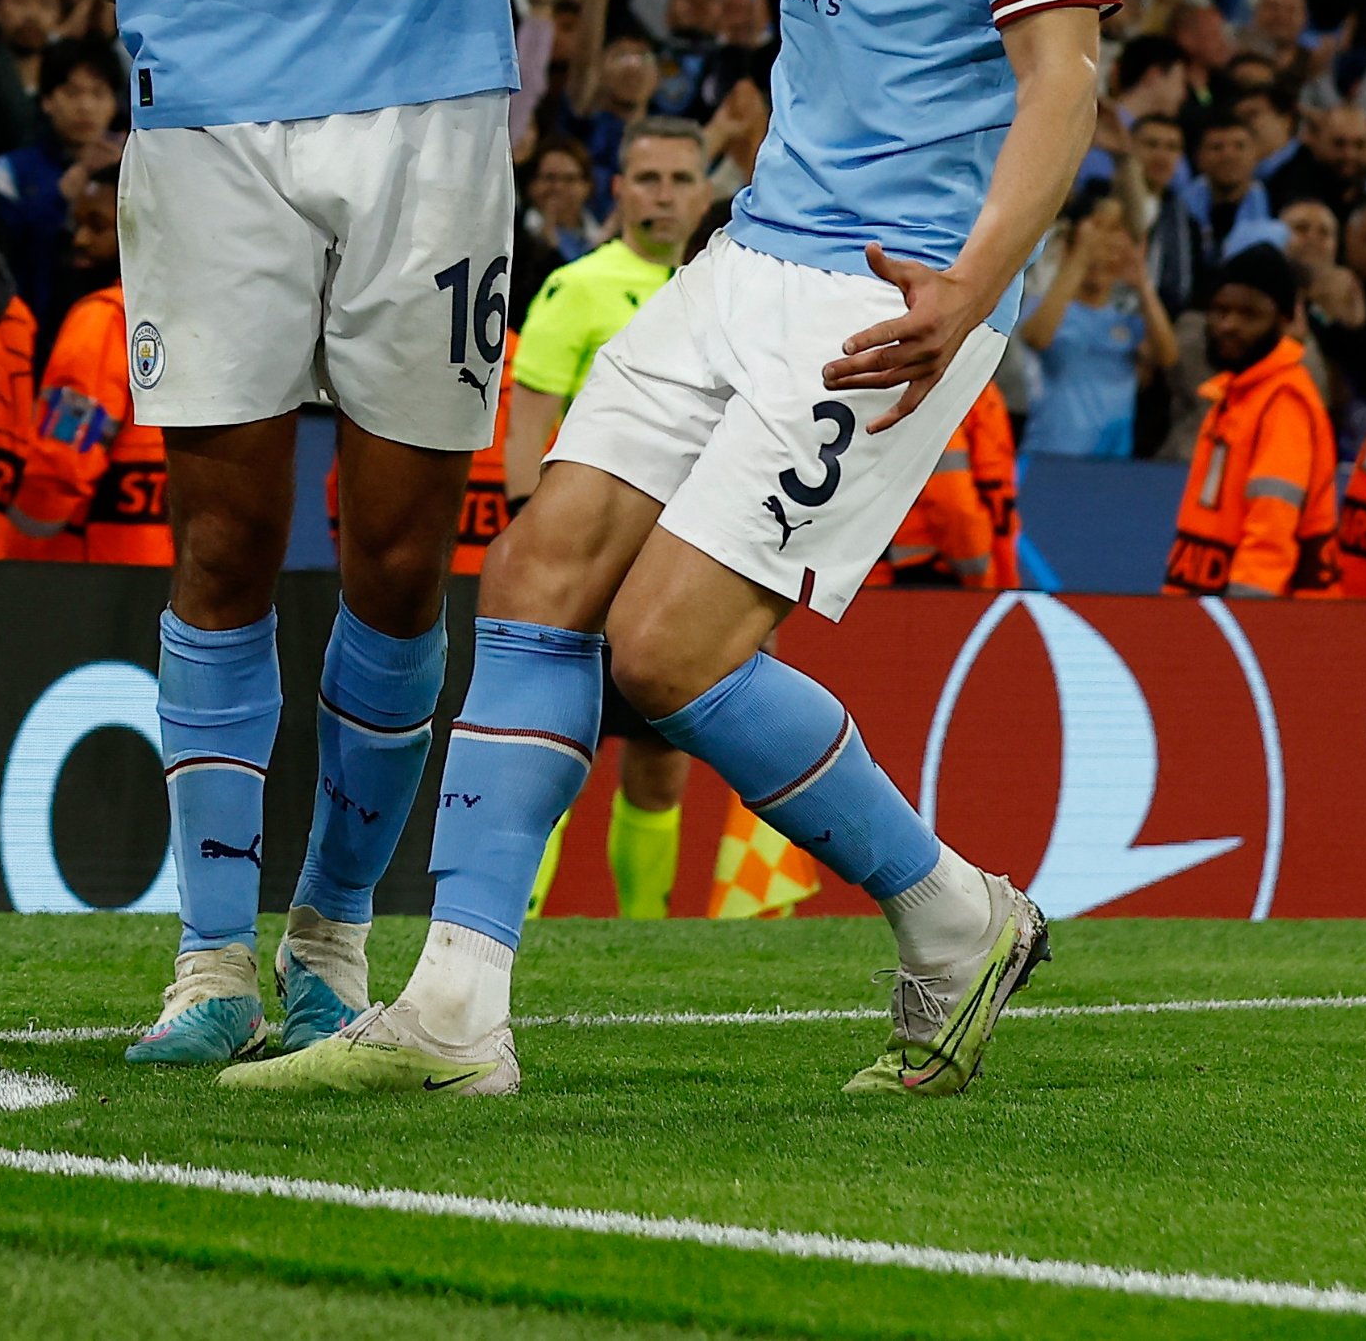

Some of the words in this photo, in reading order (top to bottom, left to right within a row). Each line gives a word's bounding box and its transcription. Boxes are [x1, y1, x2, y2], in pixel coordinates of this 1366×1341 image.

[434, 255, 508, 364] 16
[779, 400, 856, 508] 3
[324, 776, 380, 824] CITY
